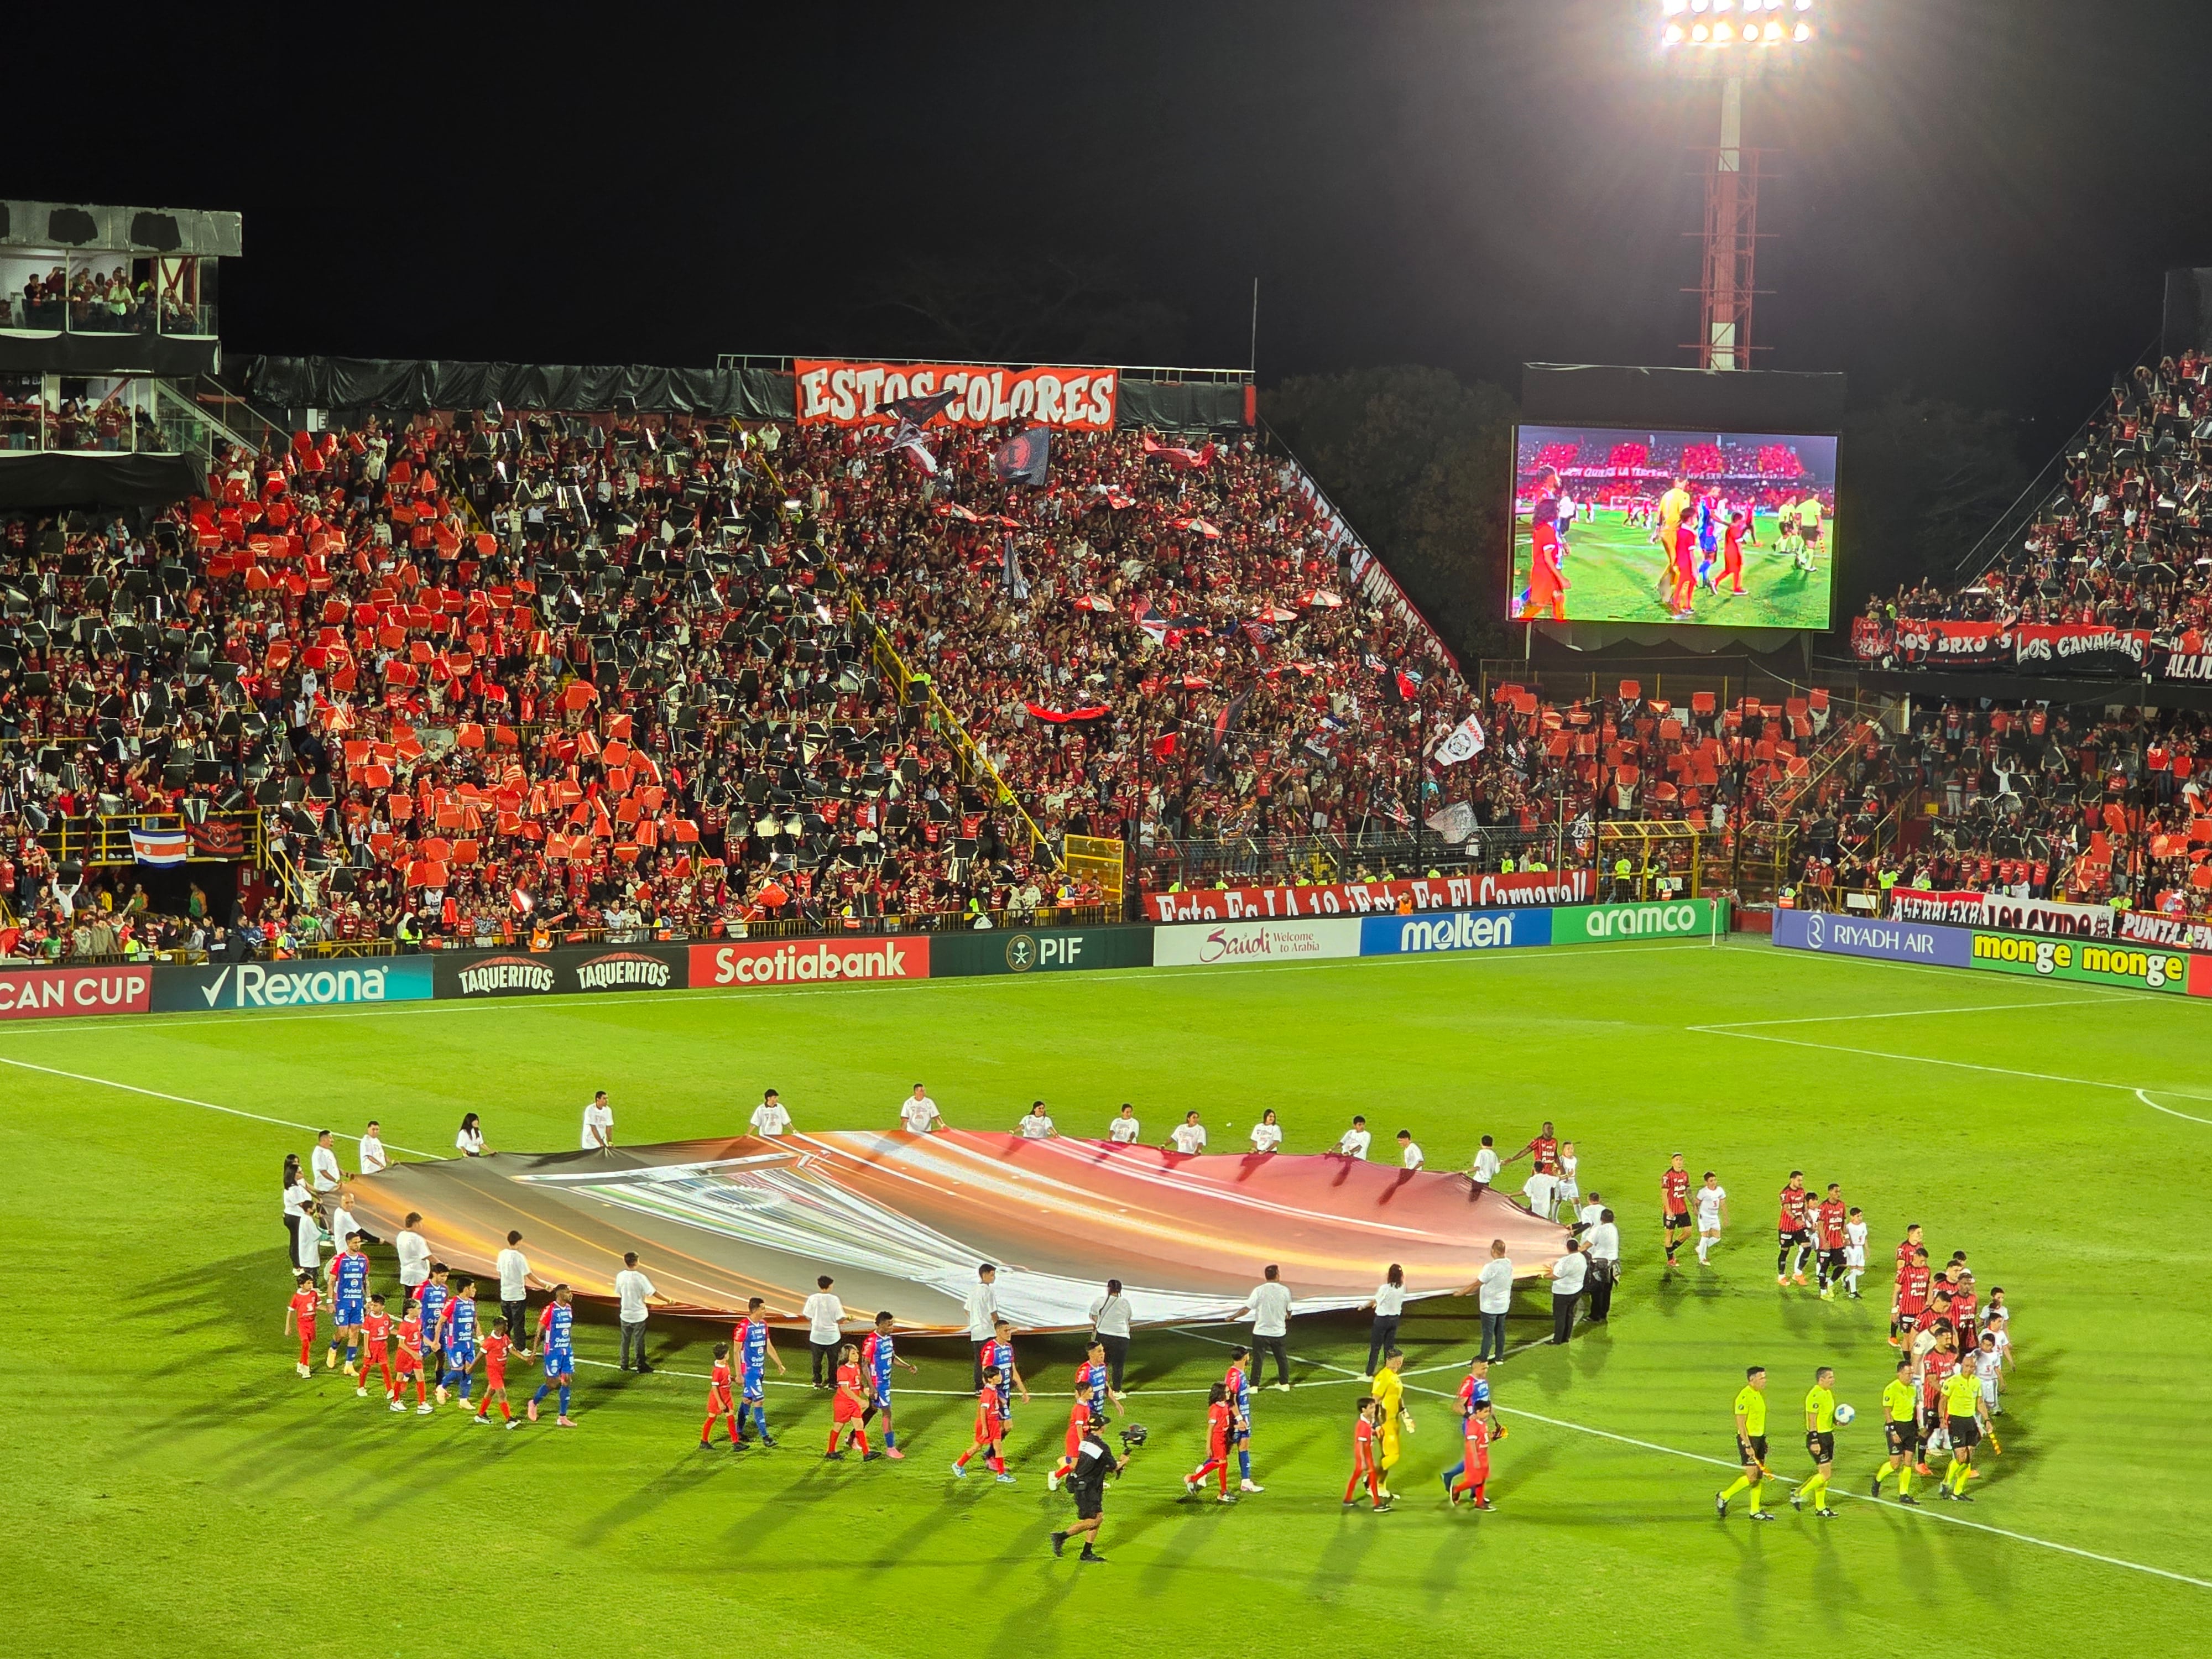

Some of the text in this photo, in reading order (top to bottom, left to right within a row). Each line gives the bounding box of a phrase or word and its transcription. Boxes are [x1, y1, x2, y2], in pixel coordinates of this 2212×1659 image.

[801, 368, 1114, 425] ESTOS COLORES
[1895, 630, 1931, 651] LOS
[1937, 633, 2012, 654] BRXJS
[2016, 632, 2052, 665] LOS
[2057, 631, 2143, 662] CANALLAS
[1273, 931, 1314, 942] Welcome
[1400, 912, 1512, 951] molten
[1586, 905, 1696, 936] aramco
[1040, 937, 1083, 964] PIF
[1199, 926, 1272, 963] Saudi
[1280, 941, 1320, 952] to Arabia
[1834, 924, 1934, 954] RIYADH AIR
[1974, 933, 2072, 975] monge
[576, 961, 670, 990] TAQUERITOS
[714, 941, 906, 983] Scotiabank
[2083, 946, 2184, 988] monge
[0, 976, 145, 1010] CAN CUP
[237, 964, 385, 1007] Rexona
[458, 965, 554, 994] TAQUERITOS
